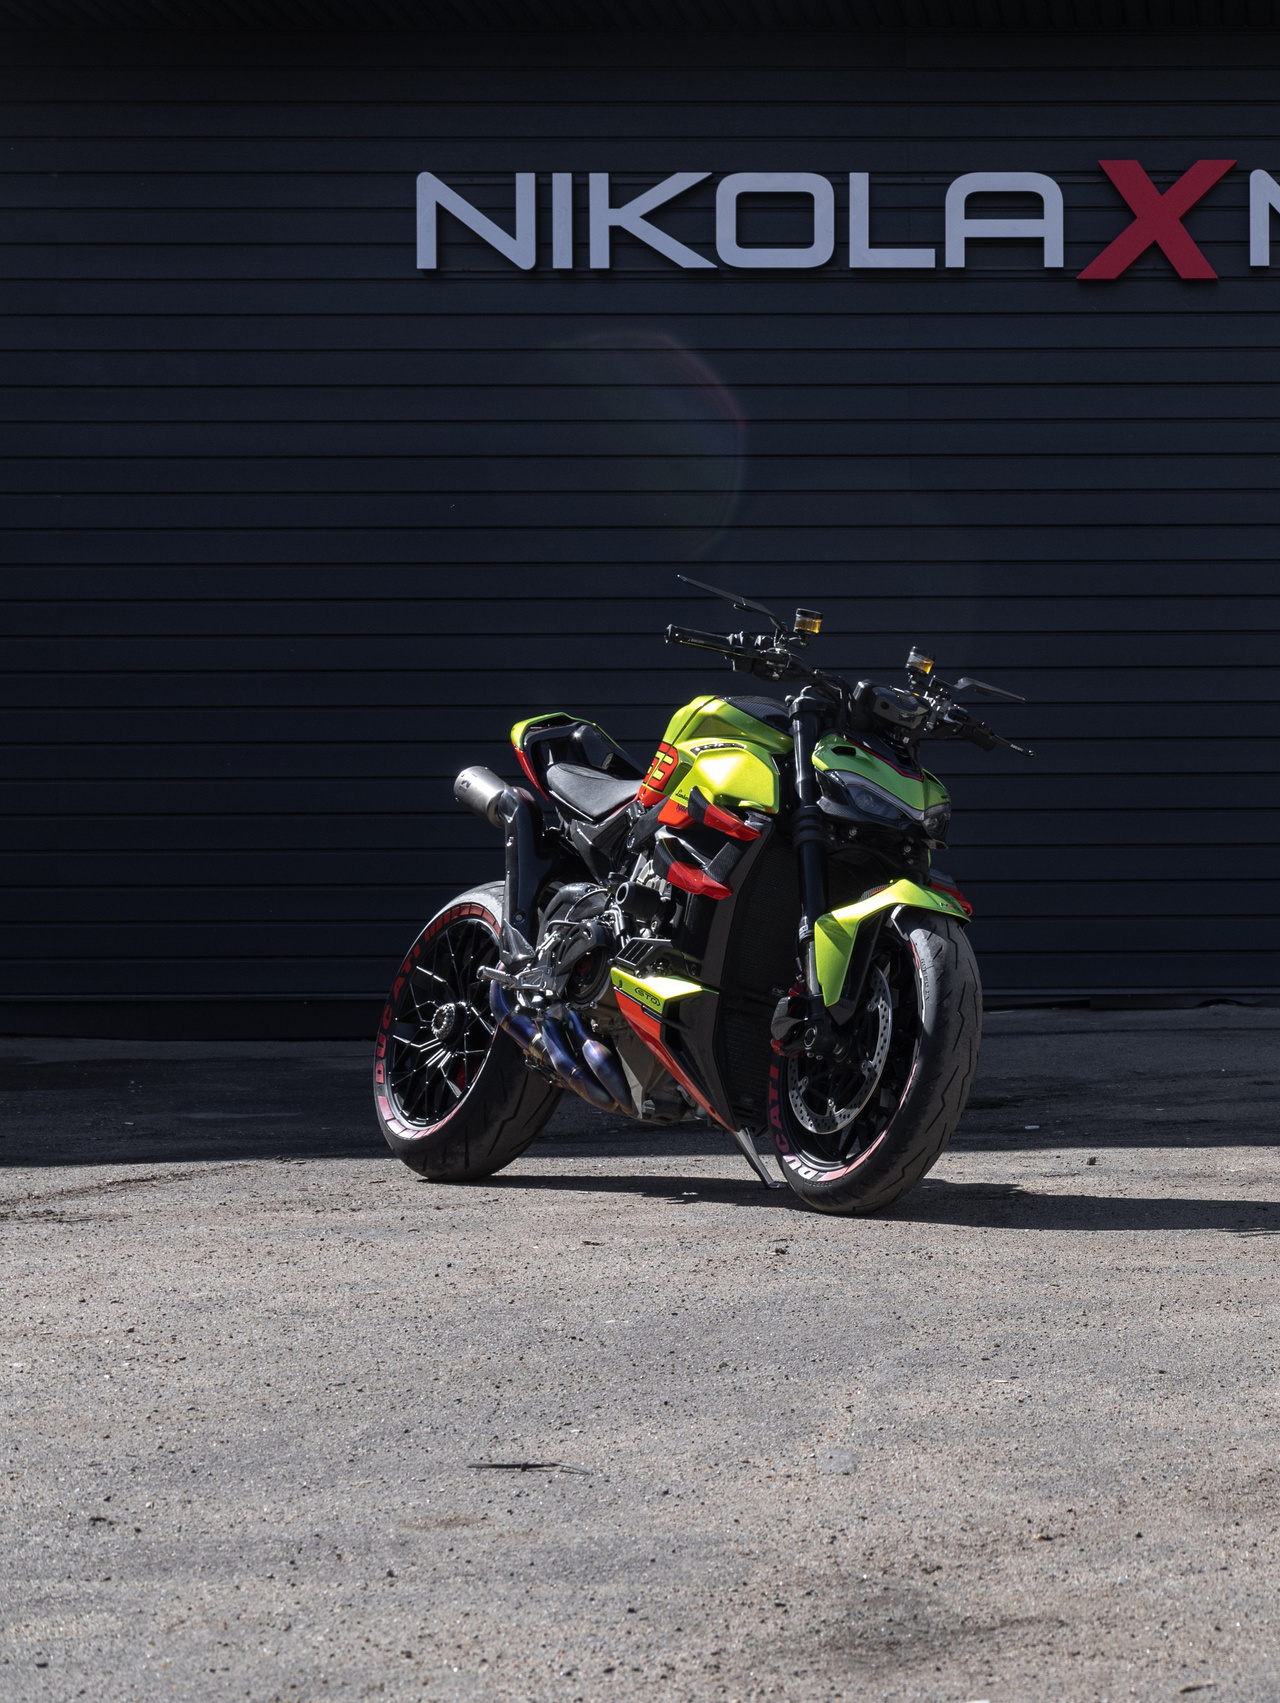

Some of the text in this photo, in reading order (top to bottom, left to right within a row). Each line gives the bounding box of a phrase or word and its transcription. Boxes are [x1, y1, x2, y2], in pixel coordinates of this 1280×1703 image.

[415, 171, 1064, 270] NIKOLA
[1075, 159, 1238, 280] X
[375, 943, 421, 1085] DUCATI
[637, 988, 659, 1006] STO
[768, 1063, 820, 1180] DUCATI
